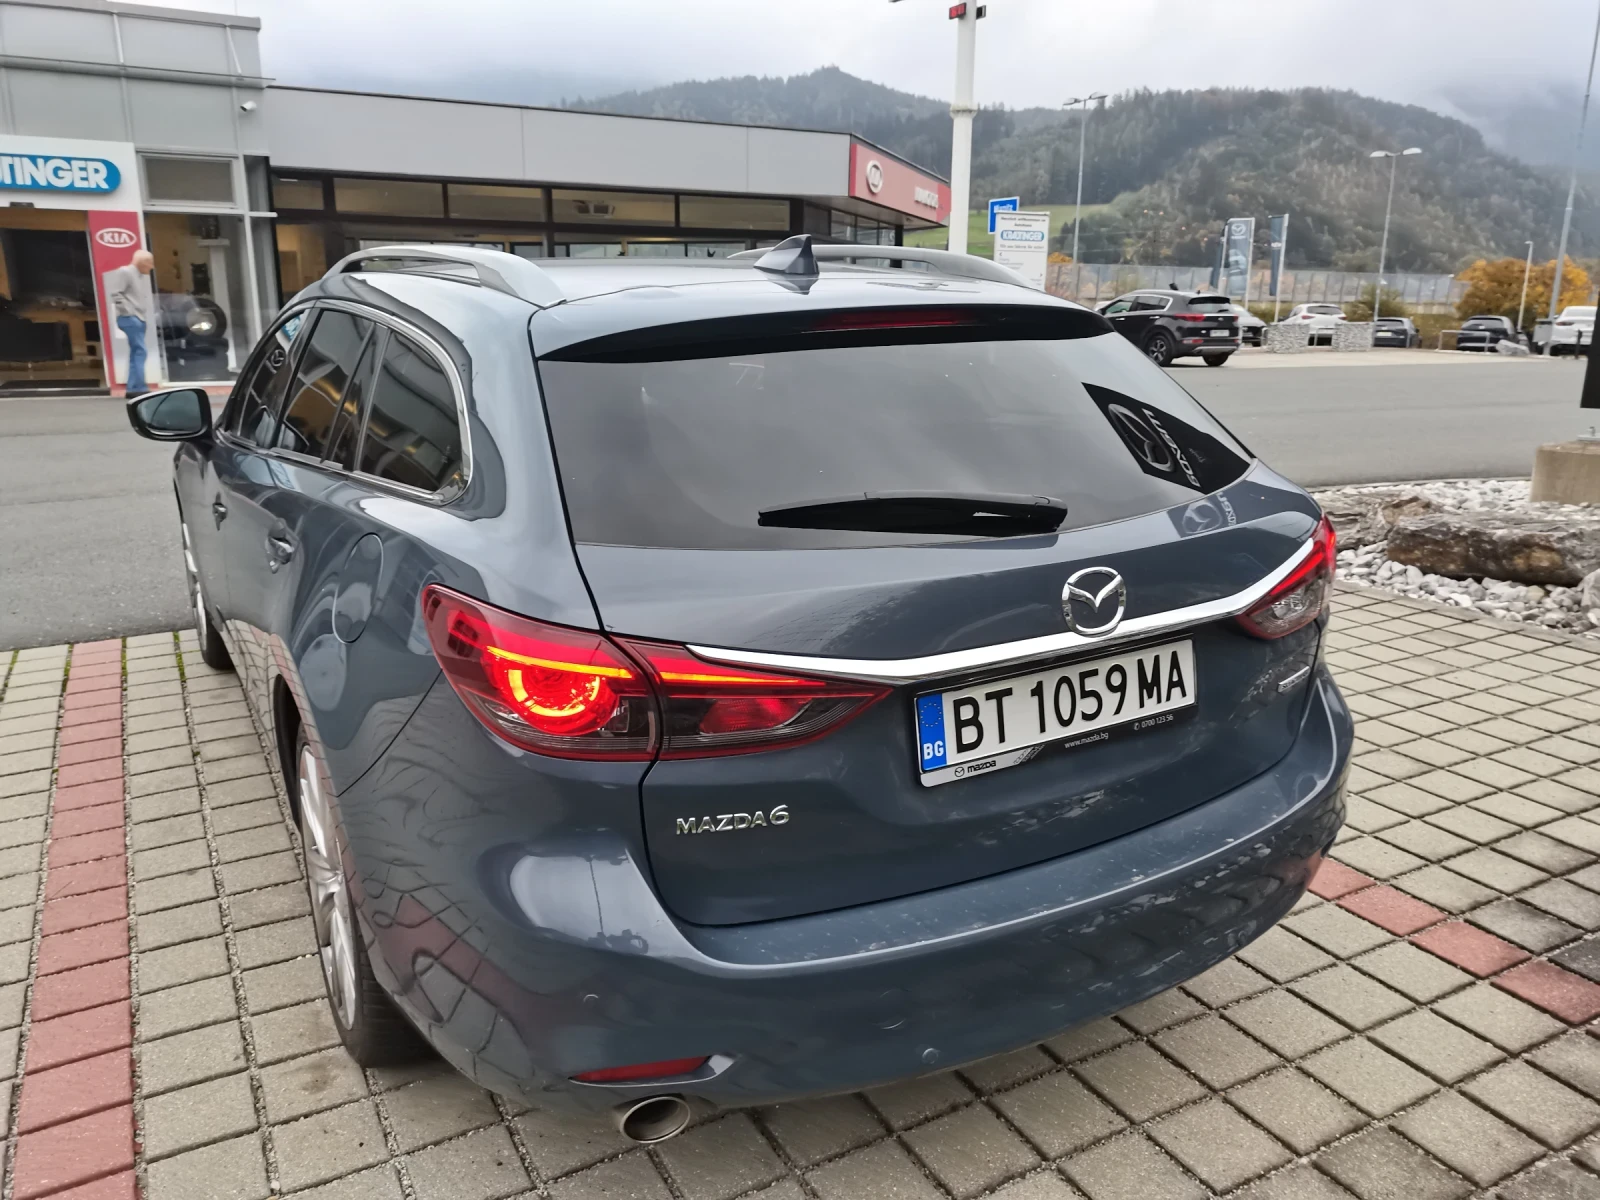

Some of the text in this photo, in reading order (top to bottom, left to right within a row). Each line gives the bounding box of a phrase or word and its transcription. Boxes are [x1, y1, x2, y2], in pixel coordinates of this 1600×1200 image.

[0, 155, 109, 189] TINGER
[103, 232, 130, 244] KIA
[953, 650, 1188, 754] BT 1059 MA
[1141, 713, 1174, 729] 0700 123 56
[1064, 731, 1109, 749] www.mazda.bg
[923, 740, 944, 760] BG
[967, 760, 997, 773] mazda
